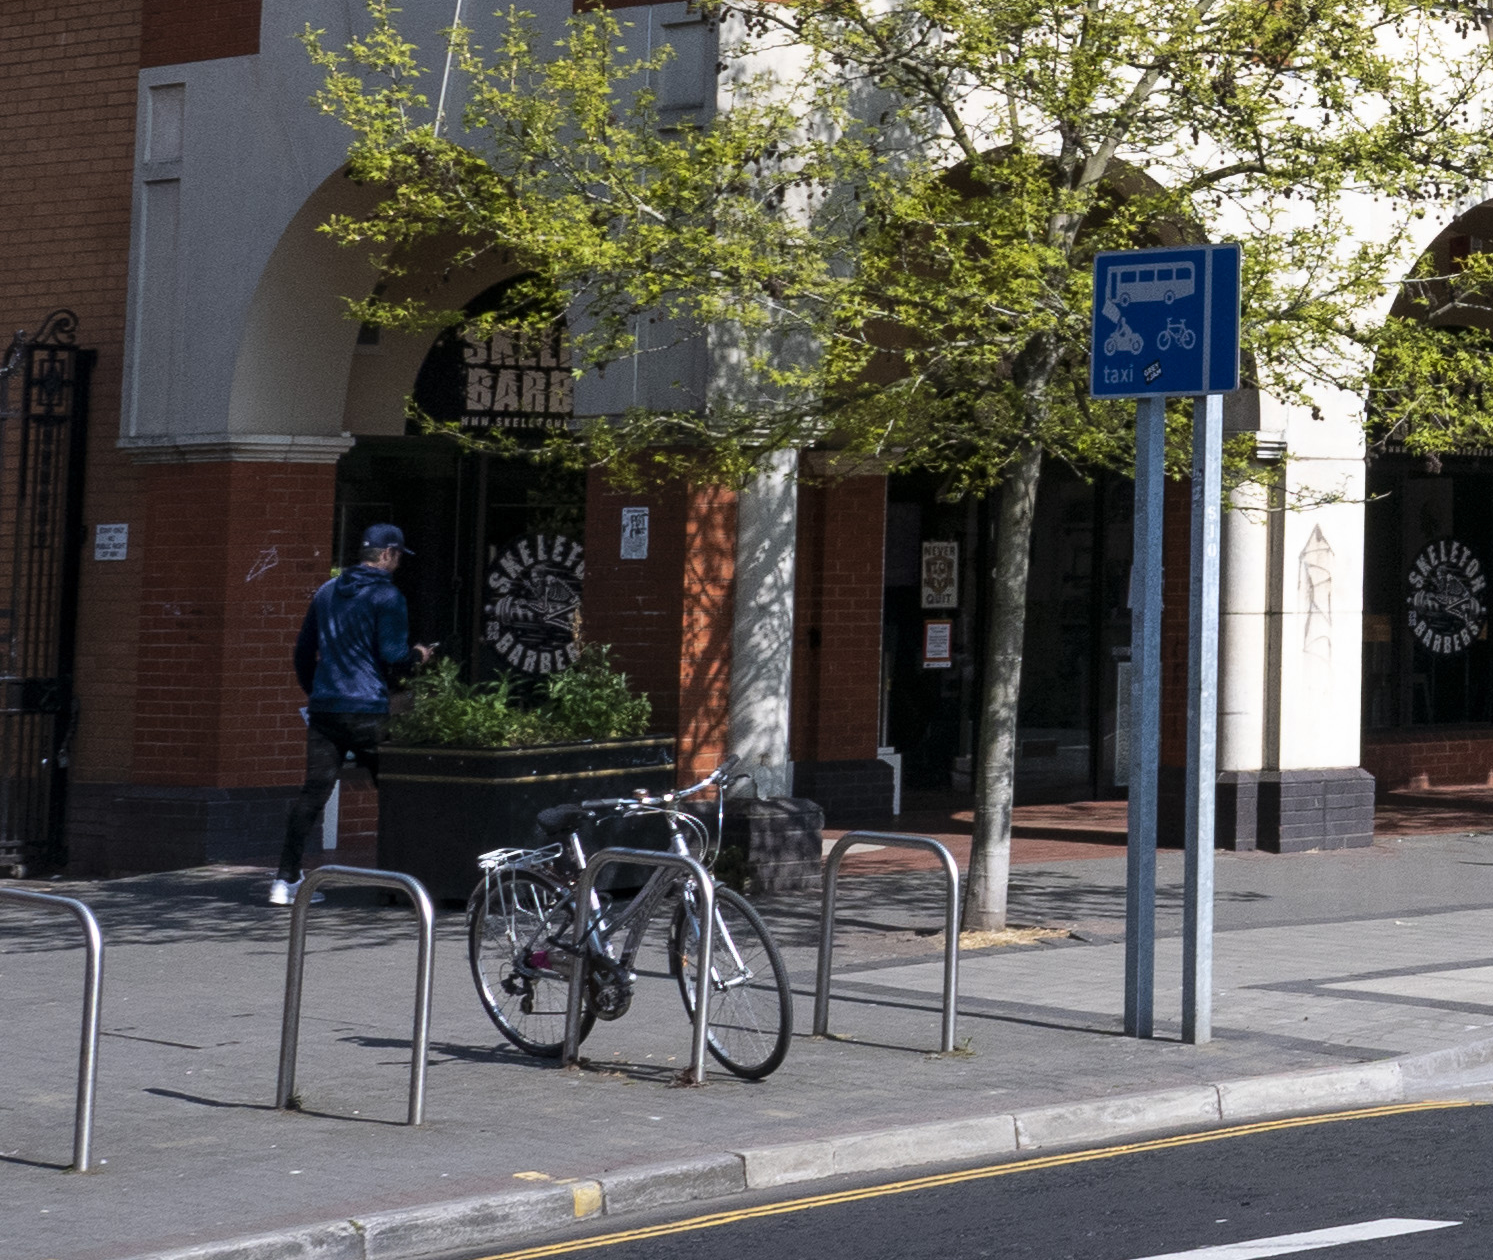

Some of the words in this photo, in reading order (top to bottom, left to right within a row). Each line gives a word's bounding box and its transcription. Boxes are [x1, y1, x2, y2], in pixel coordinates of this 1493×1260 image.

[1103, 363, 1134, 384] taxi
[1408, 540, 1487, 594] SKELETON
[1414, 620, 1480, 654] BARBERS
